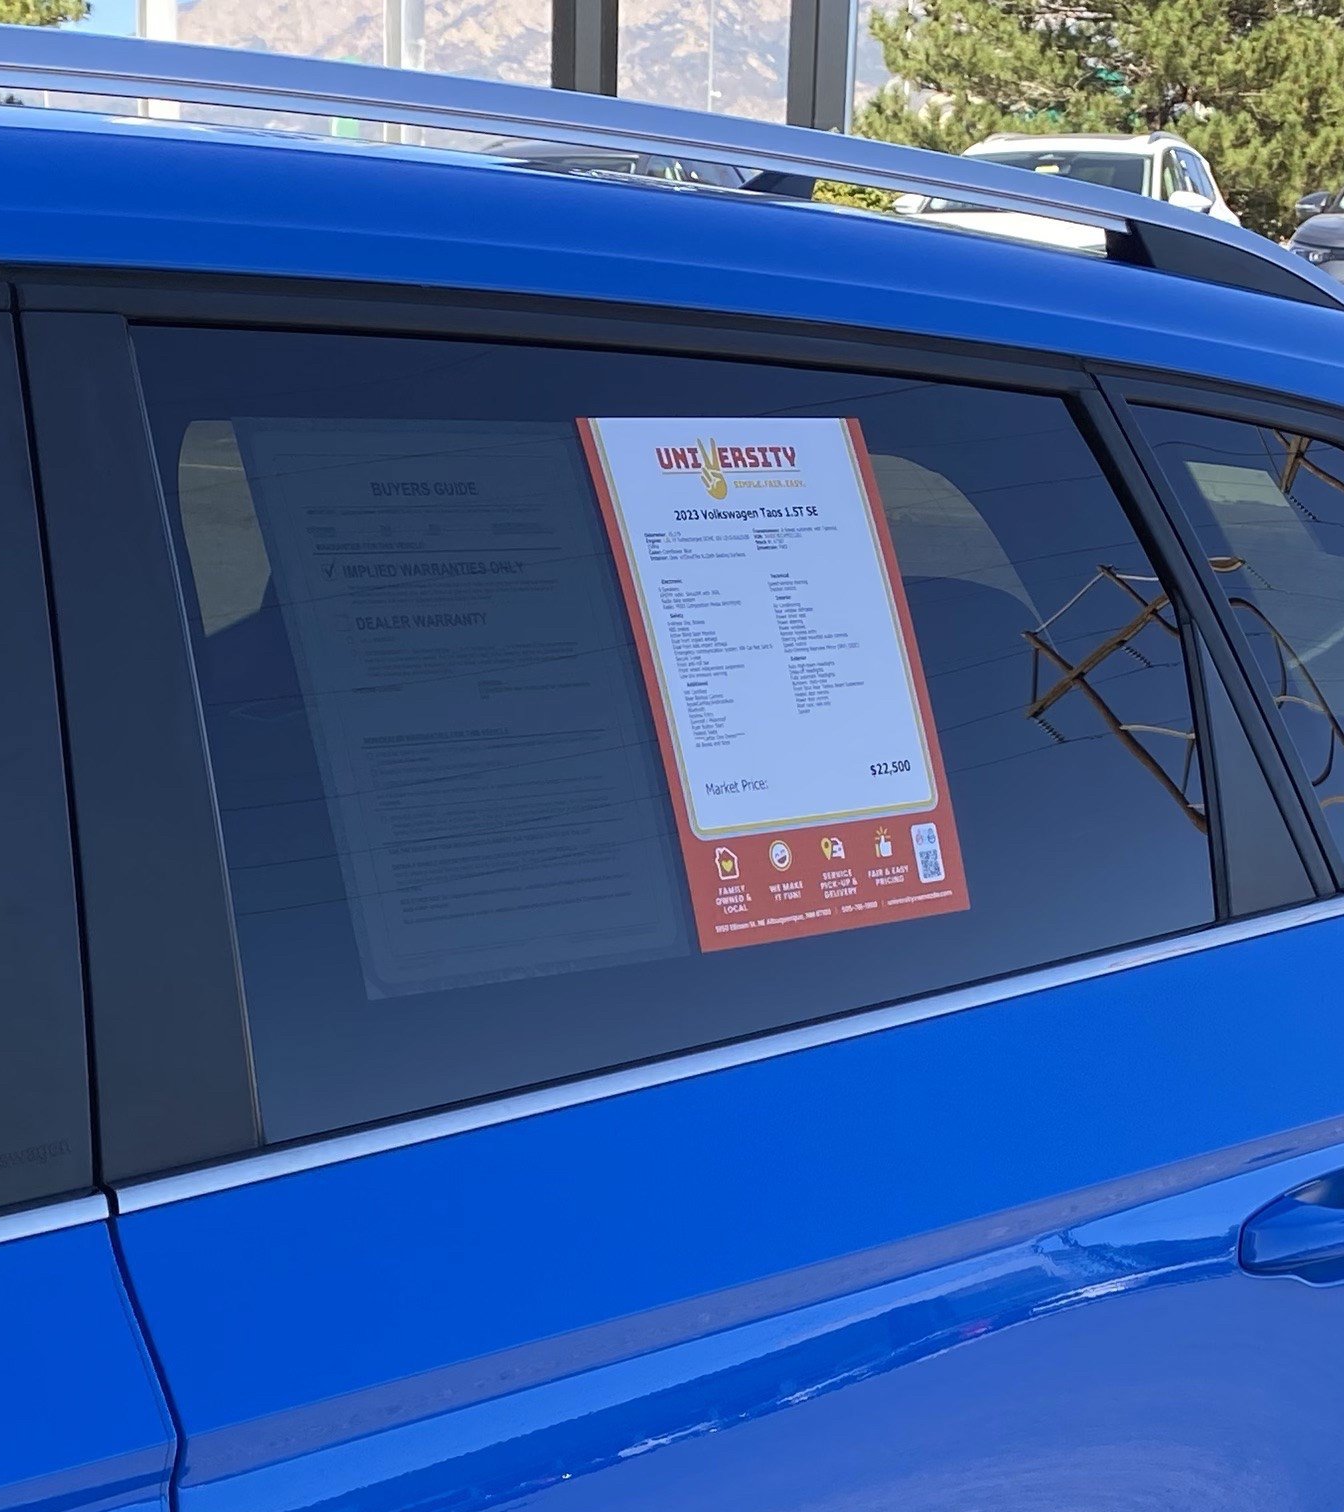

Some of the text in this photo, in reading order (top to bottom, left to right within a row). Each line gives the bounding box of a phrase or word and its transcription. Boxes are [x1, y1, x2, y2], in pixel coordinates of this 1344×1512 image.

[371, 481, 431, 496] BUYERS
[674, 505, 819, 521] 2023 Volkswagen Taos 1.5T SE
[343, 560, 526, 578] IMPLIED WARRANTIES ONLY
[356, 612, 487, 631] DEALER WARRANTY
[870, 759, 911, 776] $22,500
[706, 779, 768, 795] Market Price:
[822, 869, 853, 881] SERVICE
[868, 868, 883, 878] FAIR
[892, 865, 909, 874] EASY
[875, 875, 904, 886] PRICING
[718, 885, 745, 896] FAMILY
[769, 881, 803, 893] WE MAKE
[824, 887, 857, 899] DELIVERY
[716, 895, 744, 906] OWNED
[775, 891, 801, 901] IT FUN!
[723, 904, 748, 914] LOCAL
